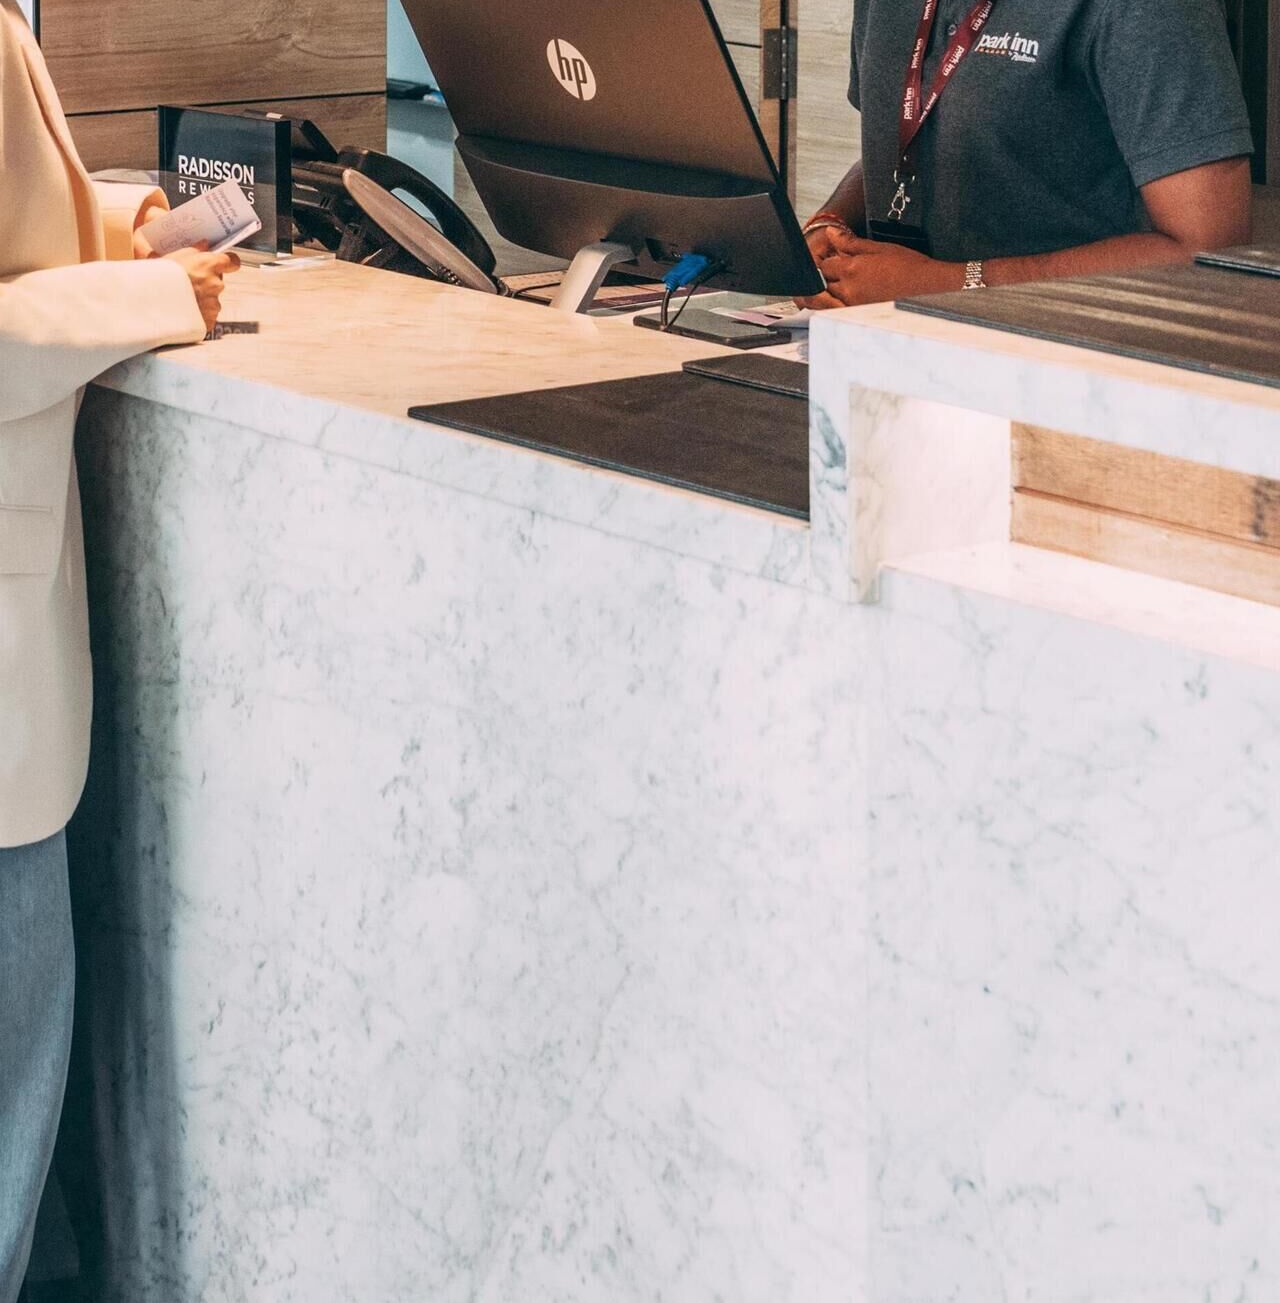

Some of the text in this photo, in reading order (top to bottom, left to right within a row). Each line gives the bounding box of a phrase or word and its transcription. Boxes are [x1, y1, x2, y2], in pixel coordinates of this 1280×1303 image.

[974, 31, 1039, 56] park inn
[178, 154, 254, 185] RADISSON
[178, 180, 255, 205] REWS
